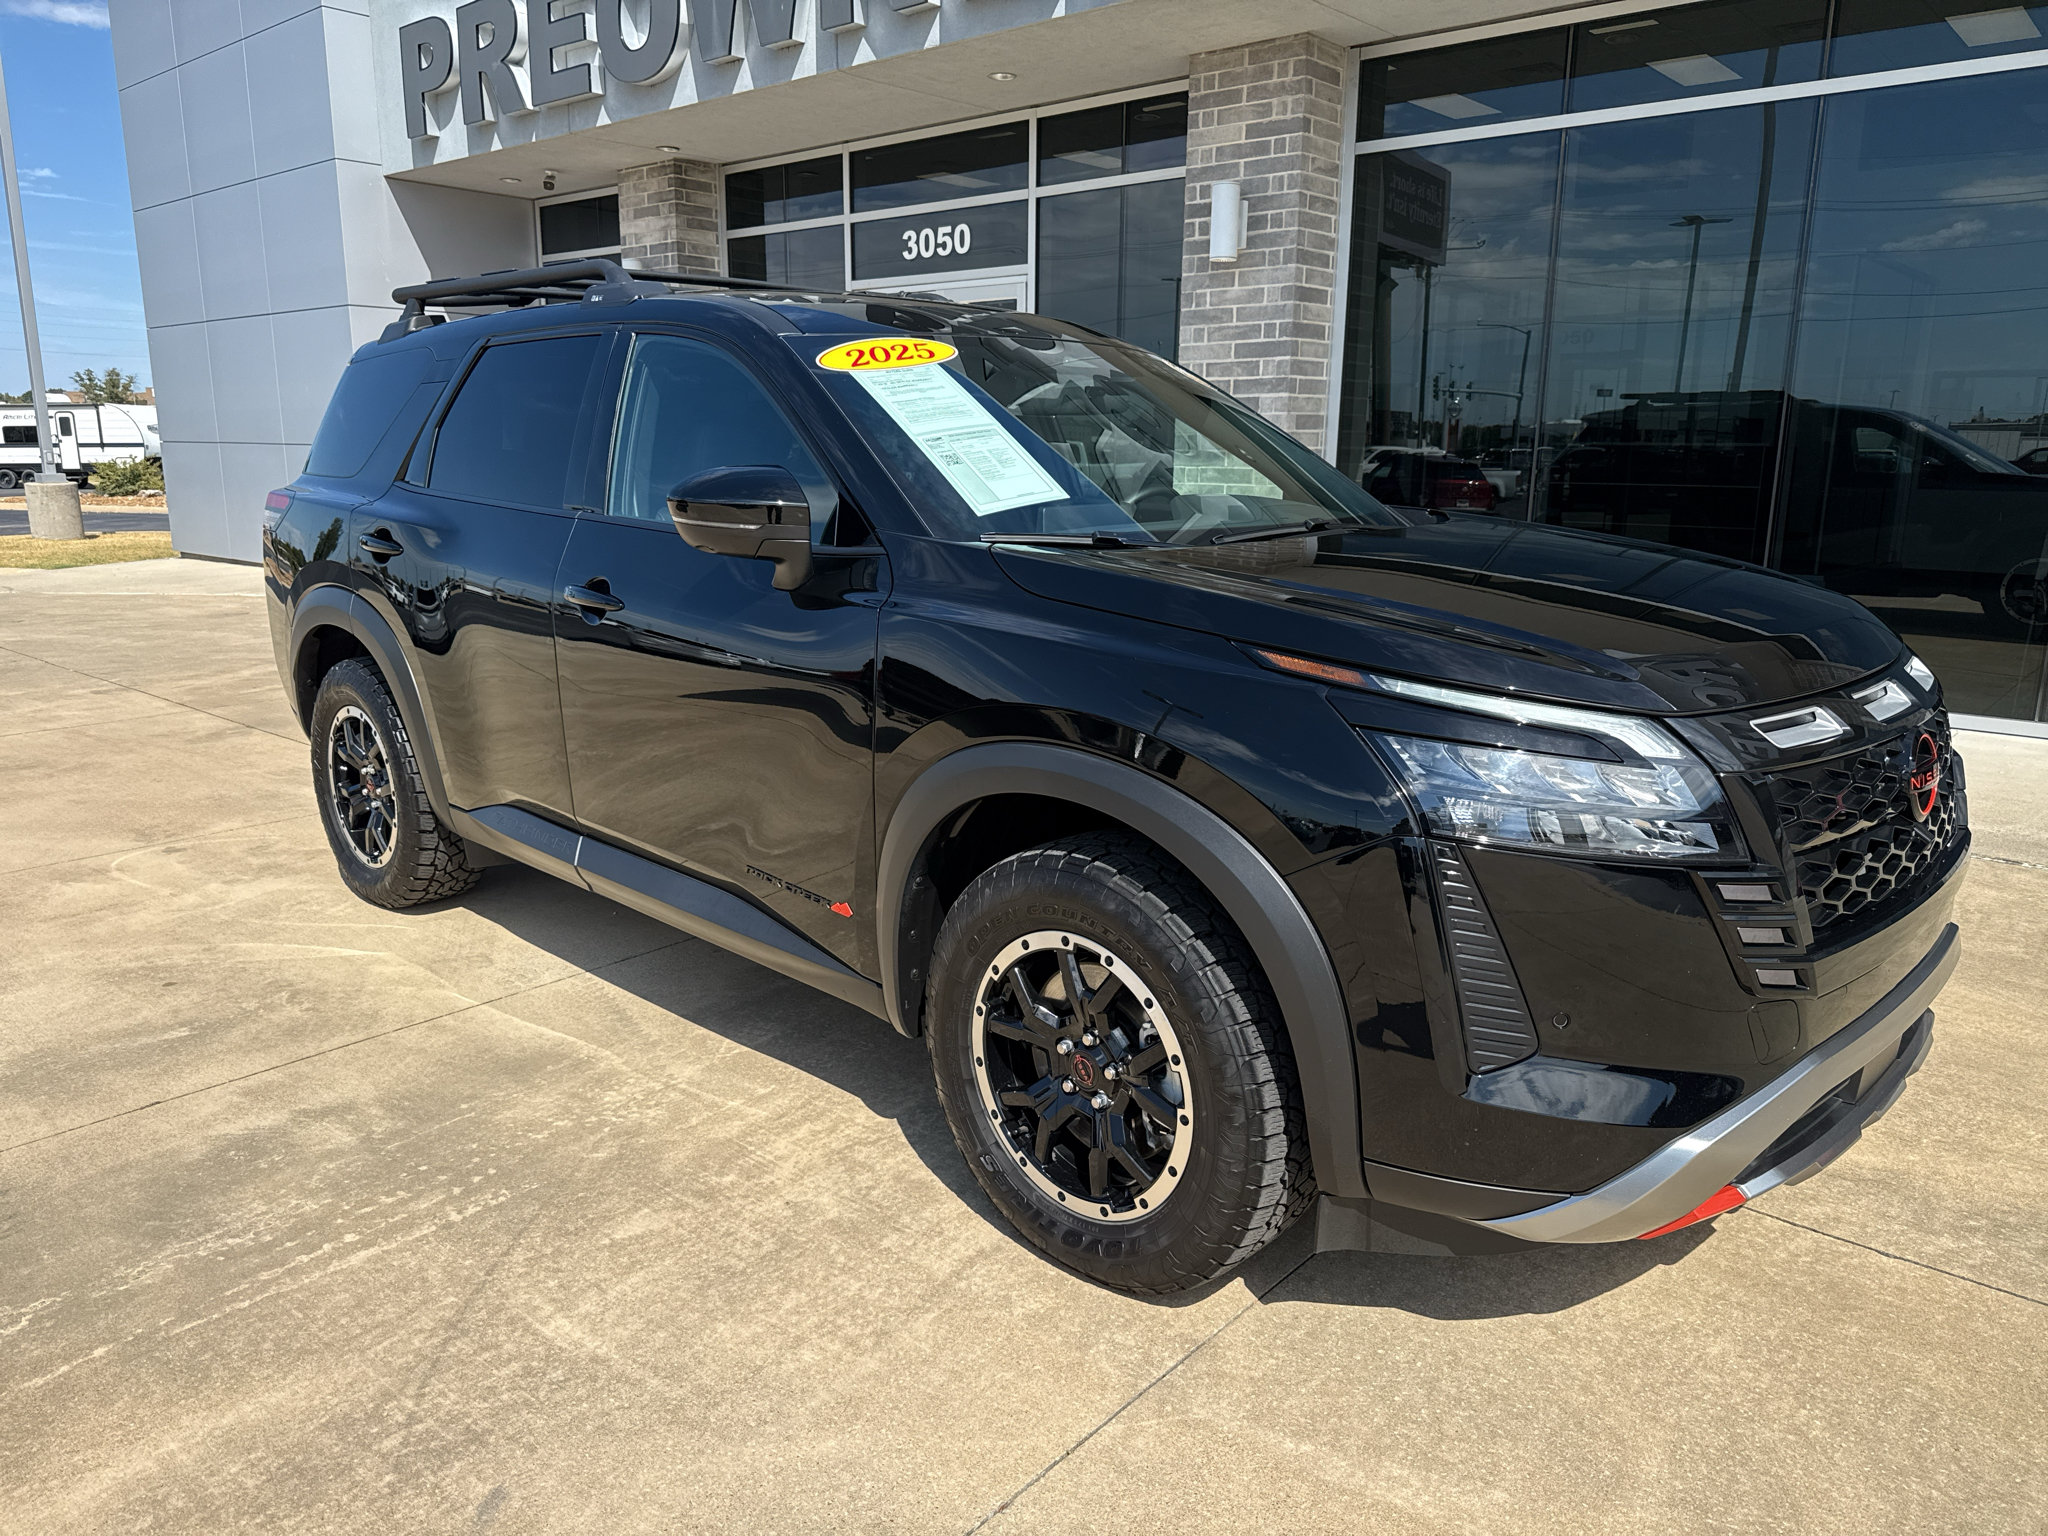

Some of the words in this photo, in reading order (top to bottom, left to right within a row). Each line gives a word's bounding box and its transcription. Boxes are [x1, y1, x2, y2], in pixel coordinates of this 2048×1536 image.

[399, 0, 938, 140] PREO
[902, 222, 971, 260] 3050
[845, 342, 936, 368] 2025
